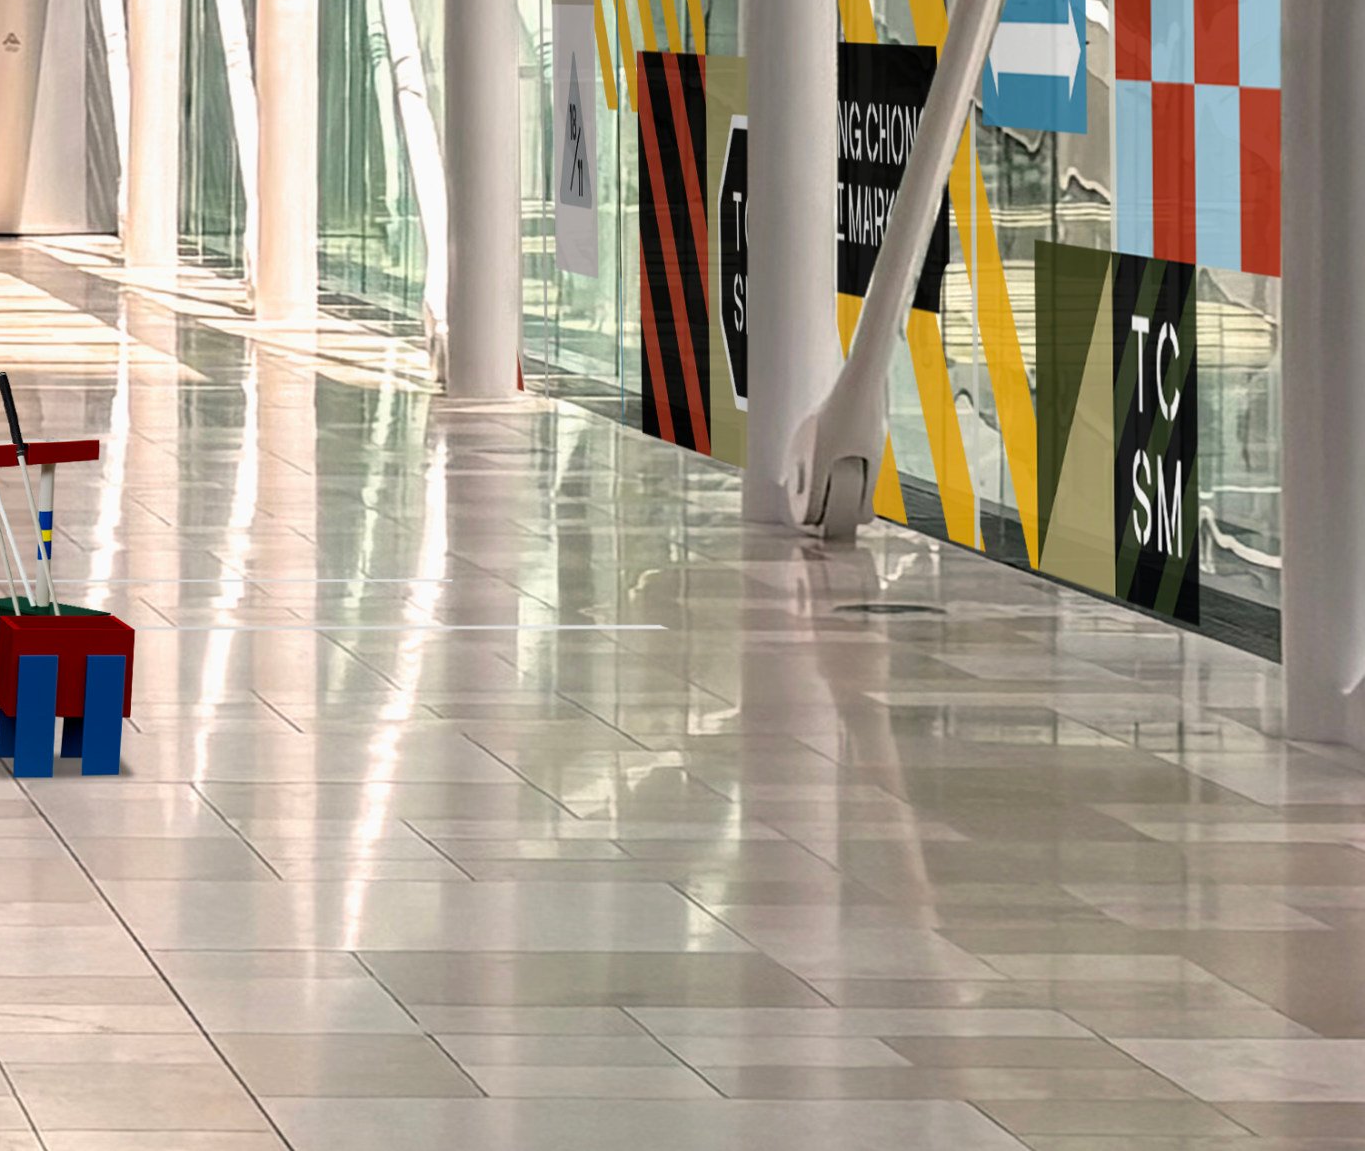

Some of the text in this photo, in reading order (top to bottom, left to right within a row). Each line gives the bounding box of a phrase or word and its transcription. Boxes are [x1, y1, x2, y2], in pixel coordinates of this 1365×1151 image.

[865, 102, 926, 166] CHON
[1131, 315, 1181, 422] TC
[1132, 448, 1183, 559] SM
